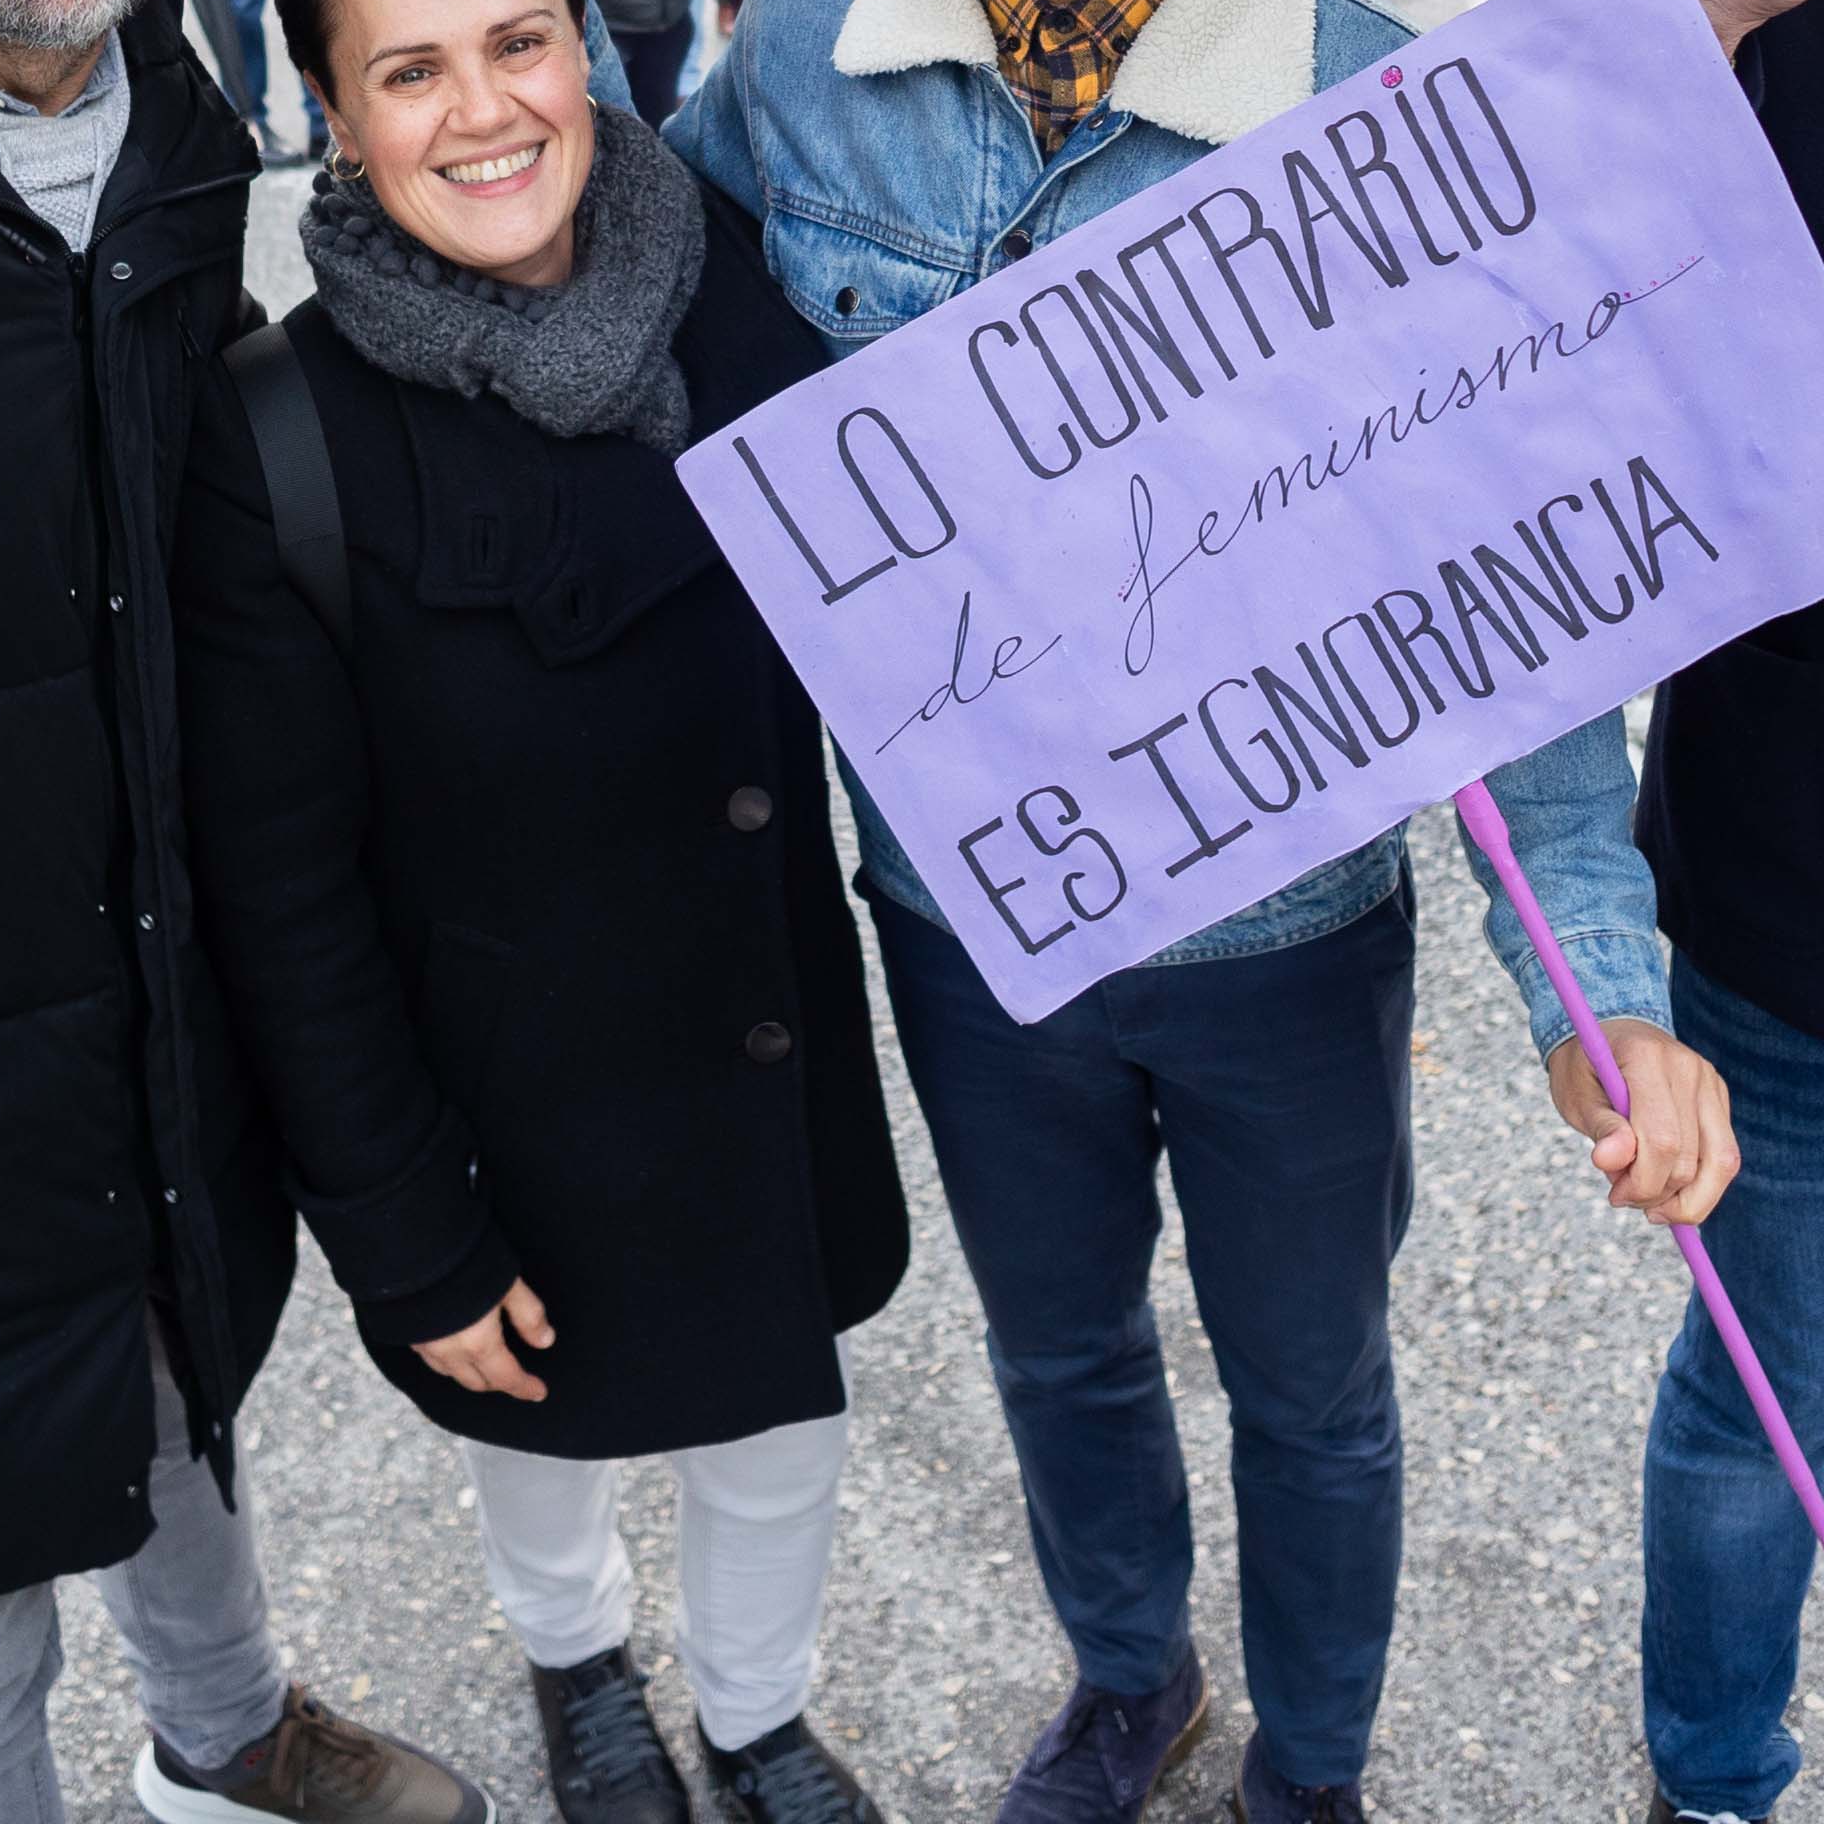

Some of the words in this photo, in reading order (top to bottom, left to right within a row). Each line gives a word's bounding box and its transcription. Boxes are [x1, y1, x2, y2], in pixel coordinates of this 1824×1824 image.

[732, 406, 959, 608] LO
[967, 57, 1538, 482] CONTRARIO
[877, 590, 1063, 755] de
[1118, 255, 1705, 678] feminismo
[957, 785, 1129, 957] ES
[1107, 455, 1720, 880] IGNORANCIA
